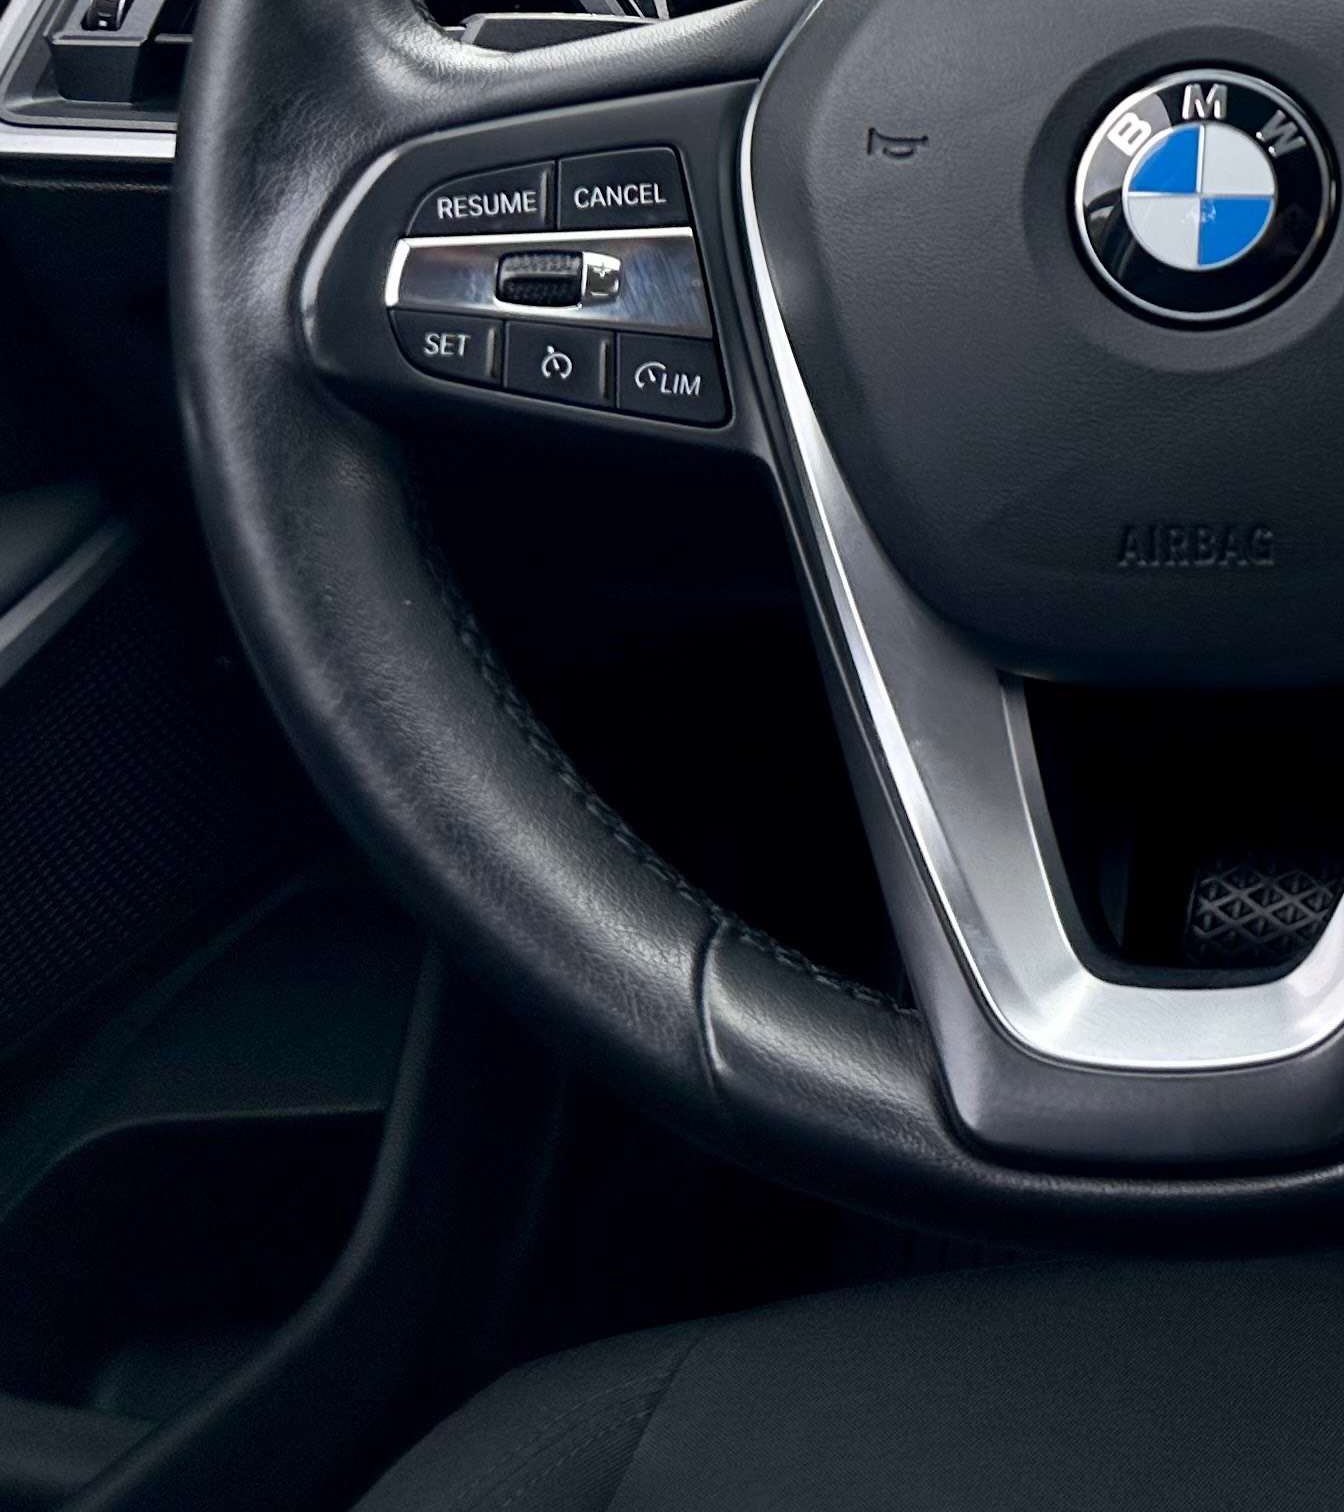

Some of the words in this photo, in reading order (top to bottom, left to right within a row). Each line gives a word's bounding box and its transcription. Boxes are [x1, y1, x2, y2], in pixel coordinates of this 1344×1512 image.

[1106, 83, 1306, 159] BMW
[437, 190, 537, 220] RESUME
[573, 183, 667, 210] CANCEL
[424, 334, 471, 357] SET
[661, 373, 701, 397] LIM
[1117, 523, 1275, 567] AIRBAG
